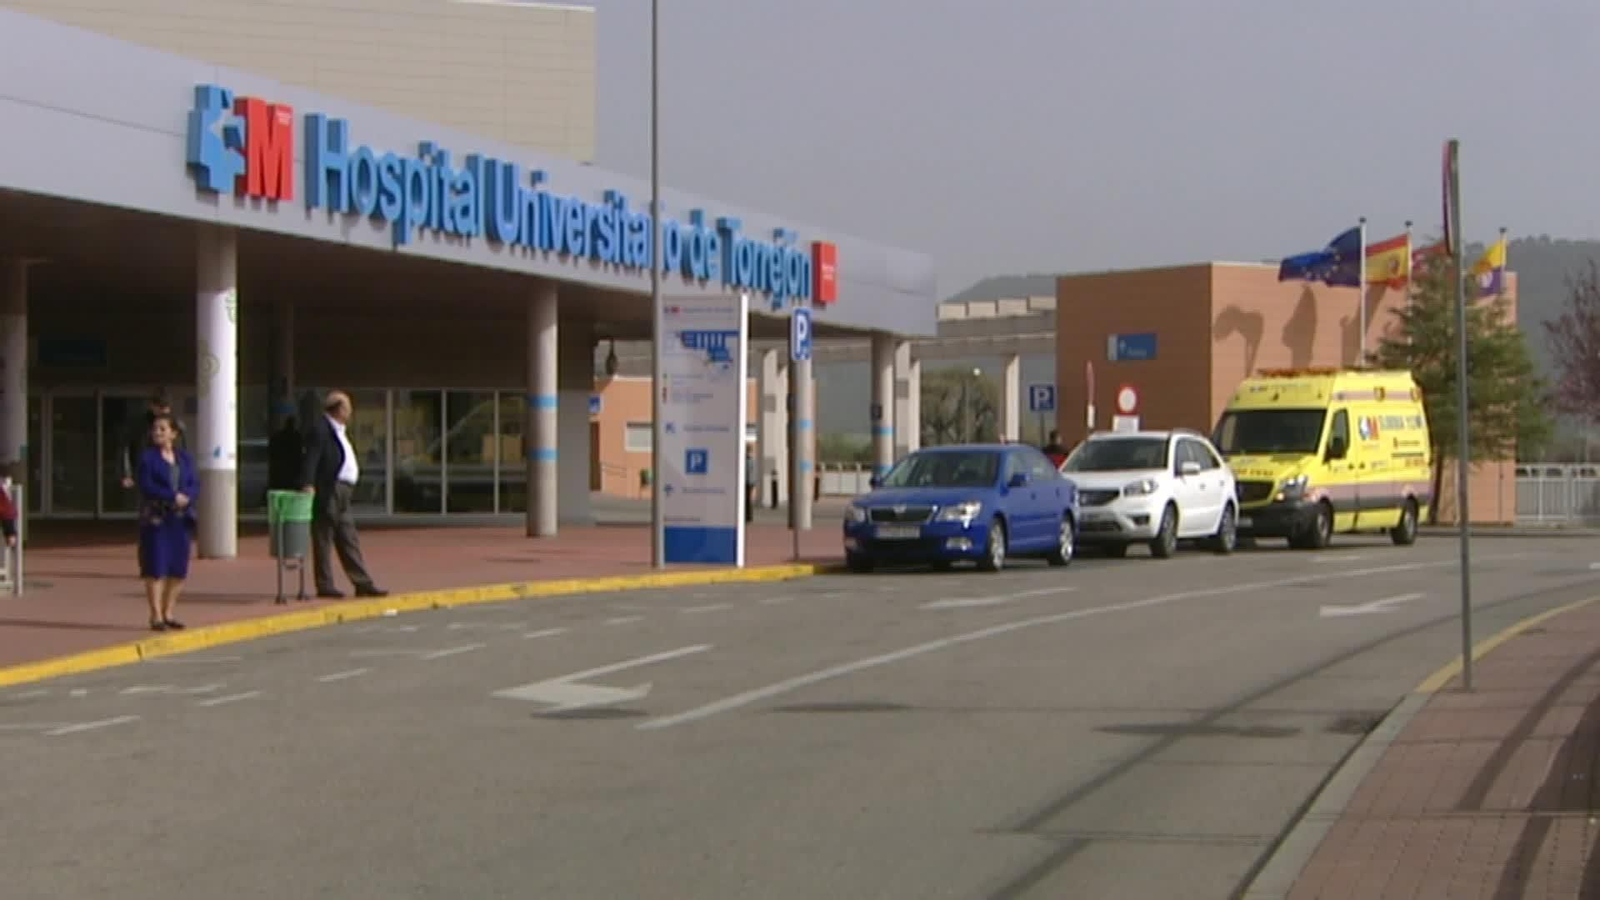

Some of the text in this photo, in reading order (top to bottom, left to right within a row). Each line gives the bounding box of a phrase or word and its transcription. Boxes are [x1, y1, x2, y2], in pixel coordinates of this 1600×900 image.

[304, 112, 485, 246] Hospital
[682, 209, 721, 280] de
[715, 217, 812, 312] Torrejón
[796, 314, 808, 354] P
[1033, 388, 1050, 410] P
[690, 451, 703, 472] P
